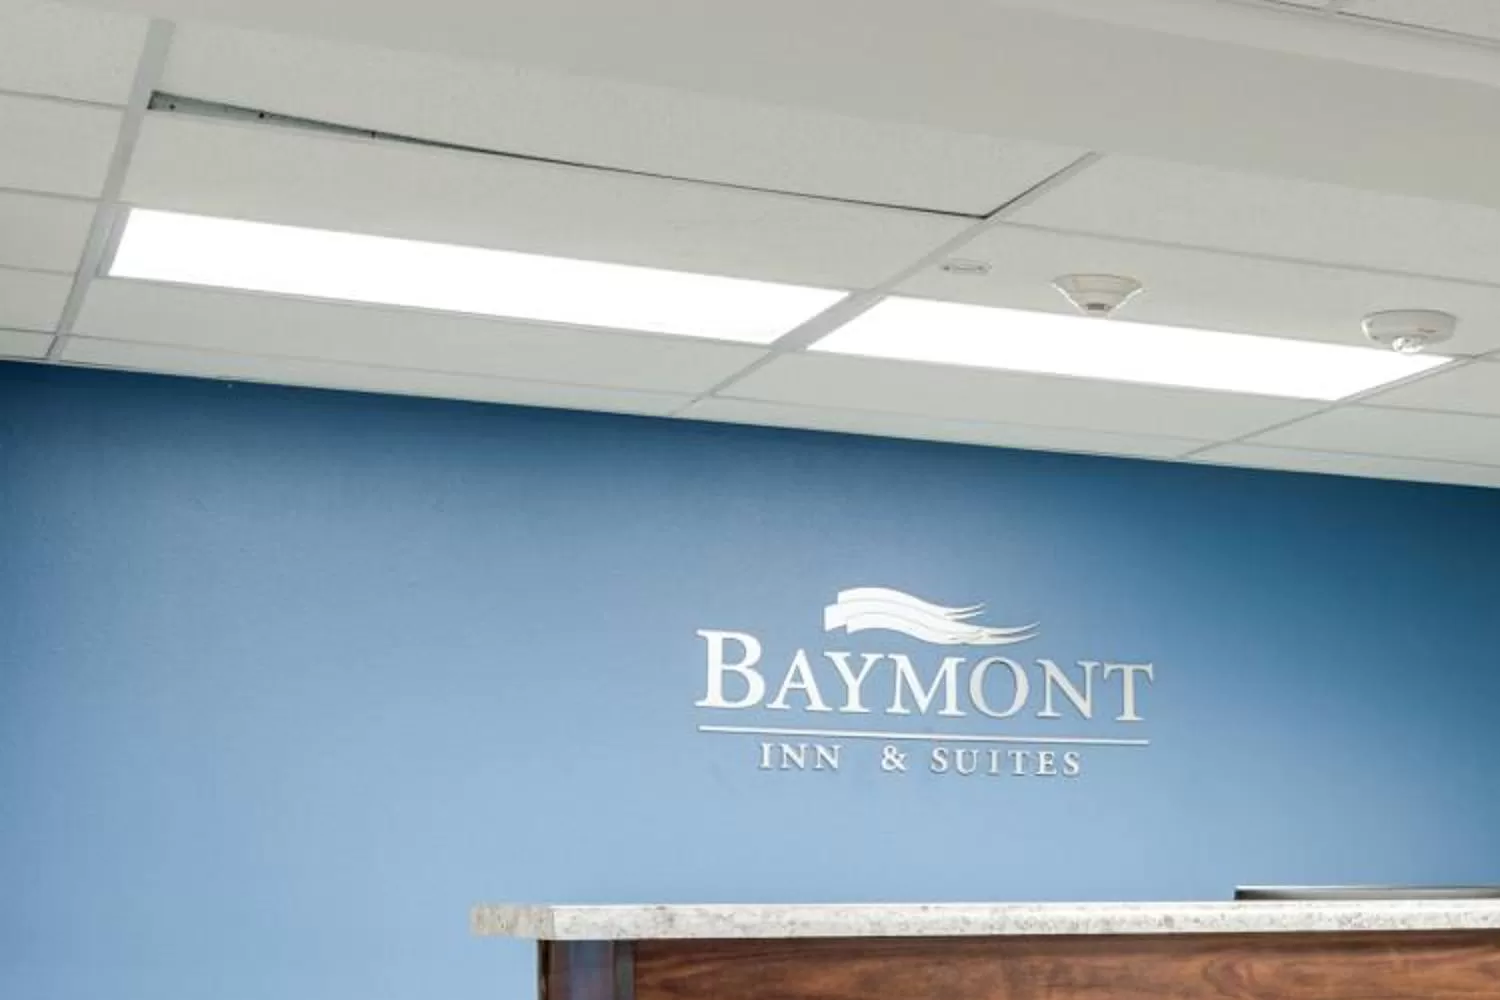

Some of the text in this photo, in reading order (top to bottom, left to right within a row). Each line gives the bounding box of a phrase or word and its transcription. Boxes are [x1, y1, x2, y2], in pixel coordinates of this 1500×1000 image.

[695, 628, 1154, 722] BAYMONT
[758, 742, 1081, 776] INN & SUITES
